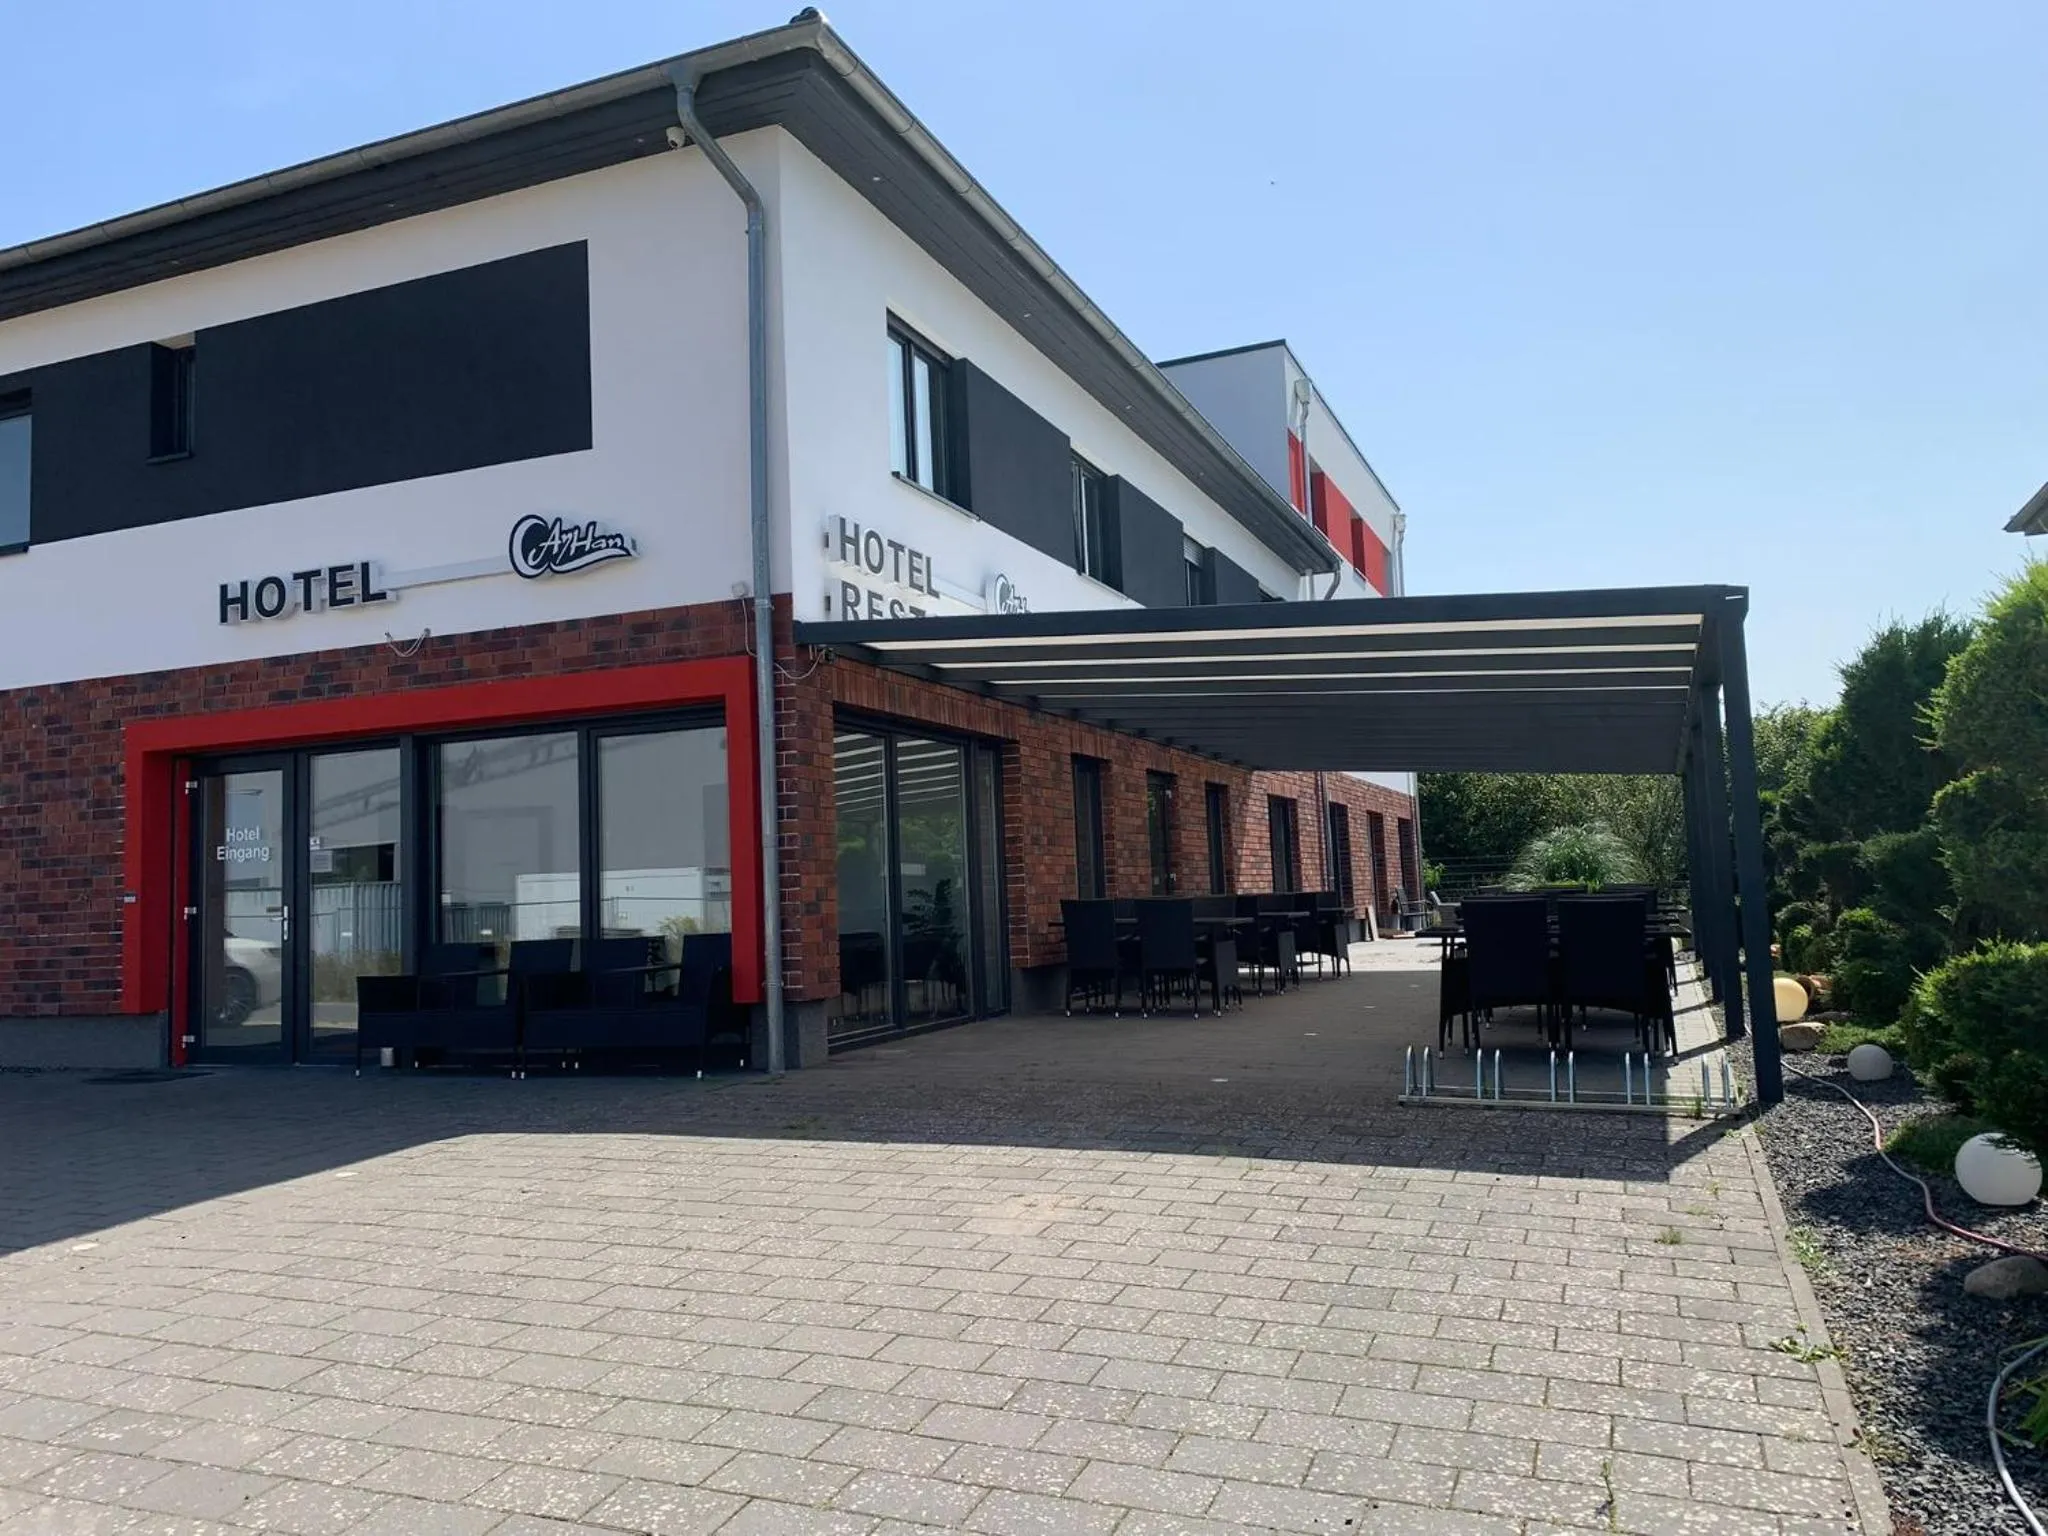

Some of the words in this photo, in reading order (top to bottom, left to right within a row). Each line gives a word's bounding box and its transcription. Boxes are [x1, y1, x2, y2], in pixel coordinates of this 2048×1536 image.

[839, 516, 940, 599] HOTEL
[219, 561, 388, 624] HOTEL
[216, 845, 270, 862] Eingang
[226, 826, 260, 842] Hotel
